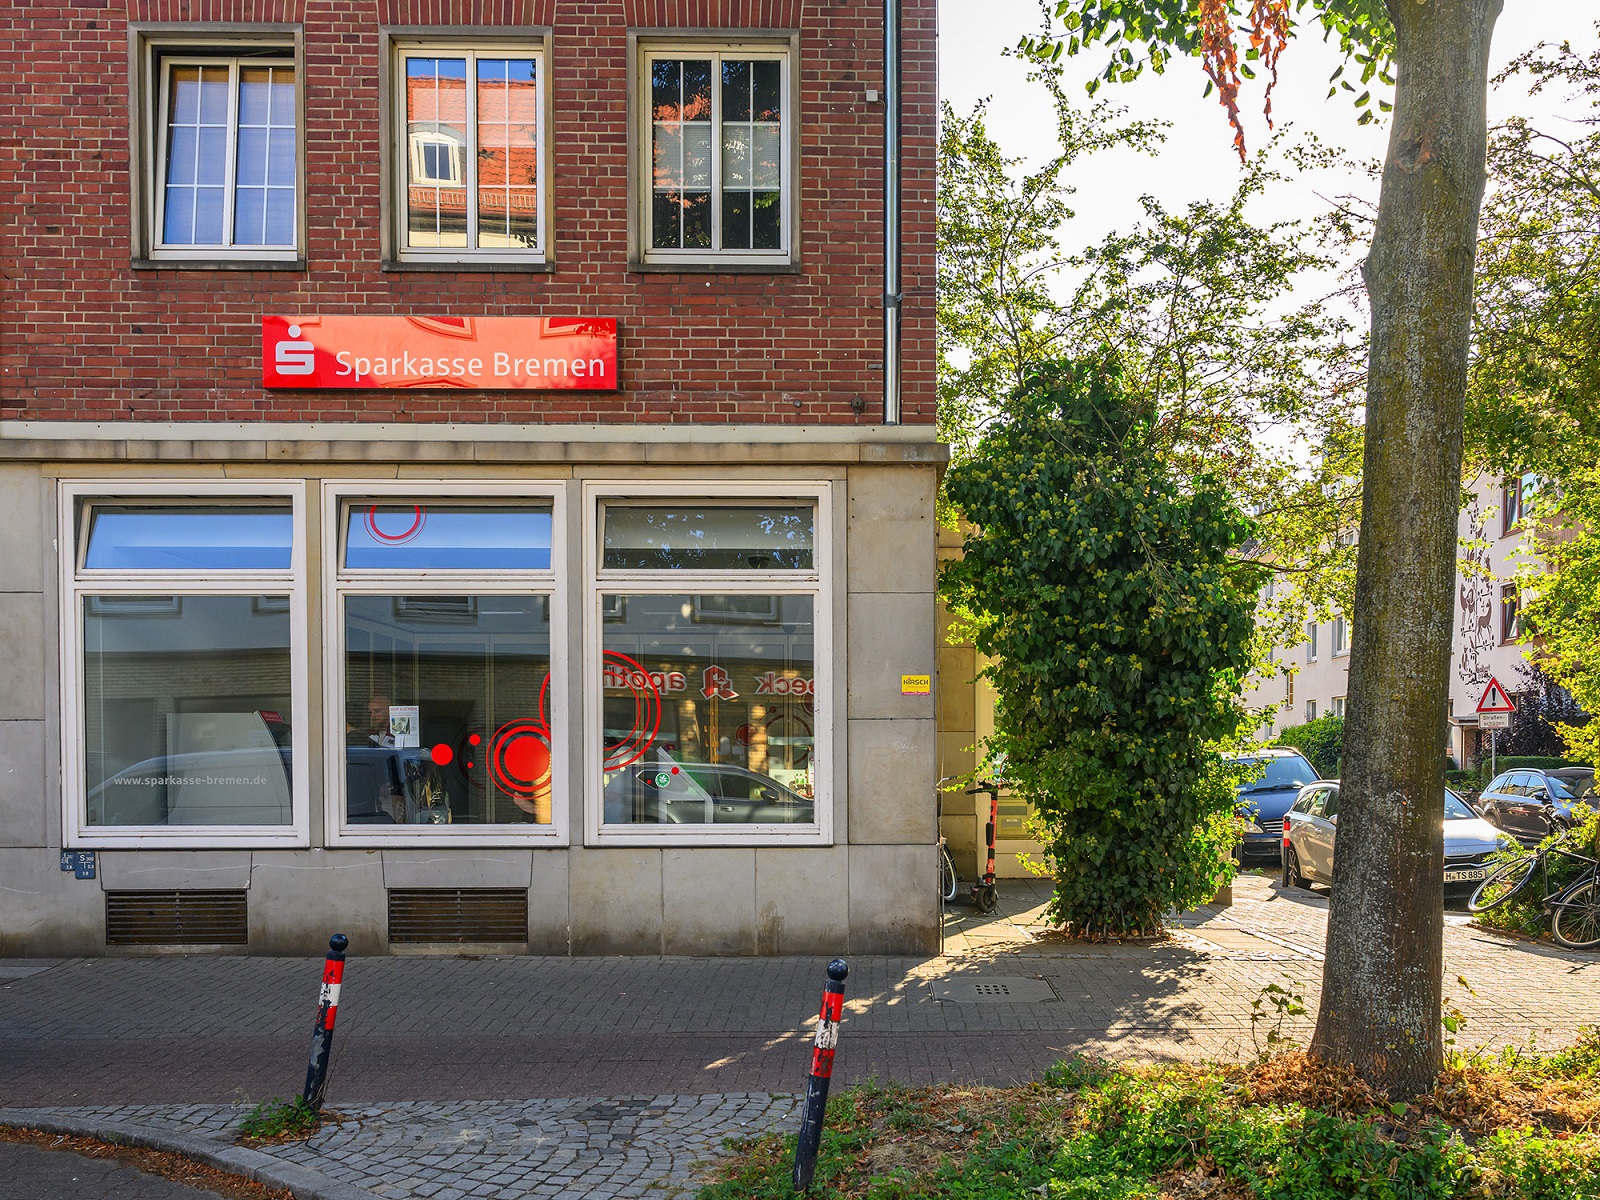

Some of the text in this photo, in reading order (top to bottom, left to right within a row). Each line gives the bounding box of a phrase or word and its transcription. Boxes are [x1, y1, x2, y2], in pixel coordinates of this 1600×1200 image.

[335, 350, 605, 381] Sparkasse Bremen
[113, 775, 267, 787] www.sparkasse-bremen.de
[1456, 871, 1467, 880] TS
[1468, 870, 1483, 879] 885
